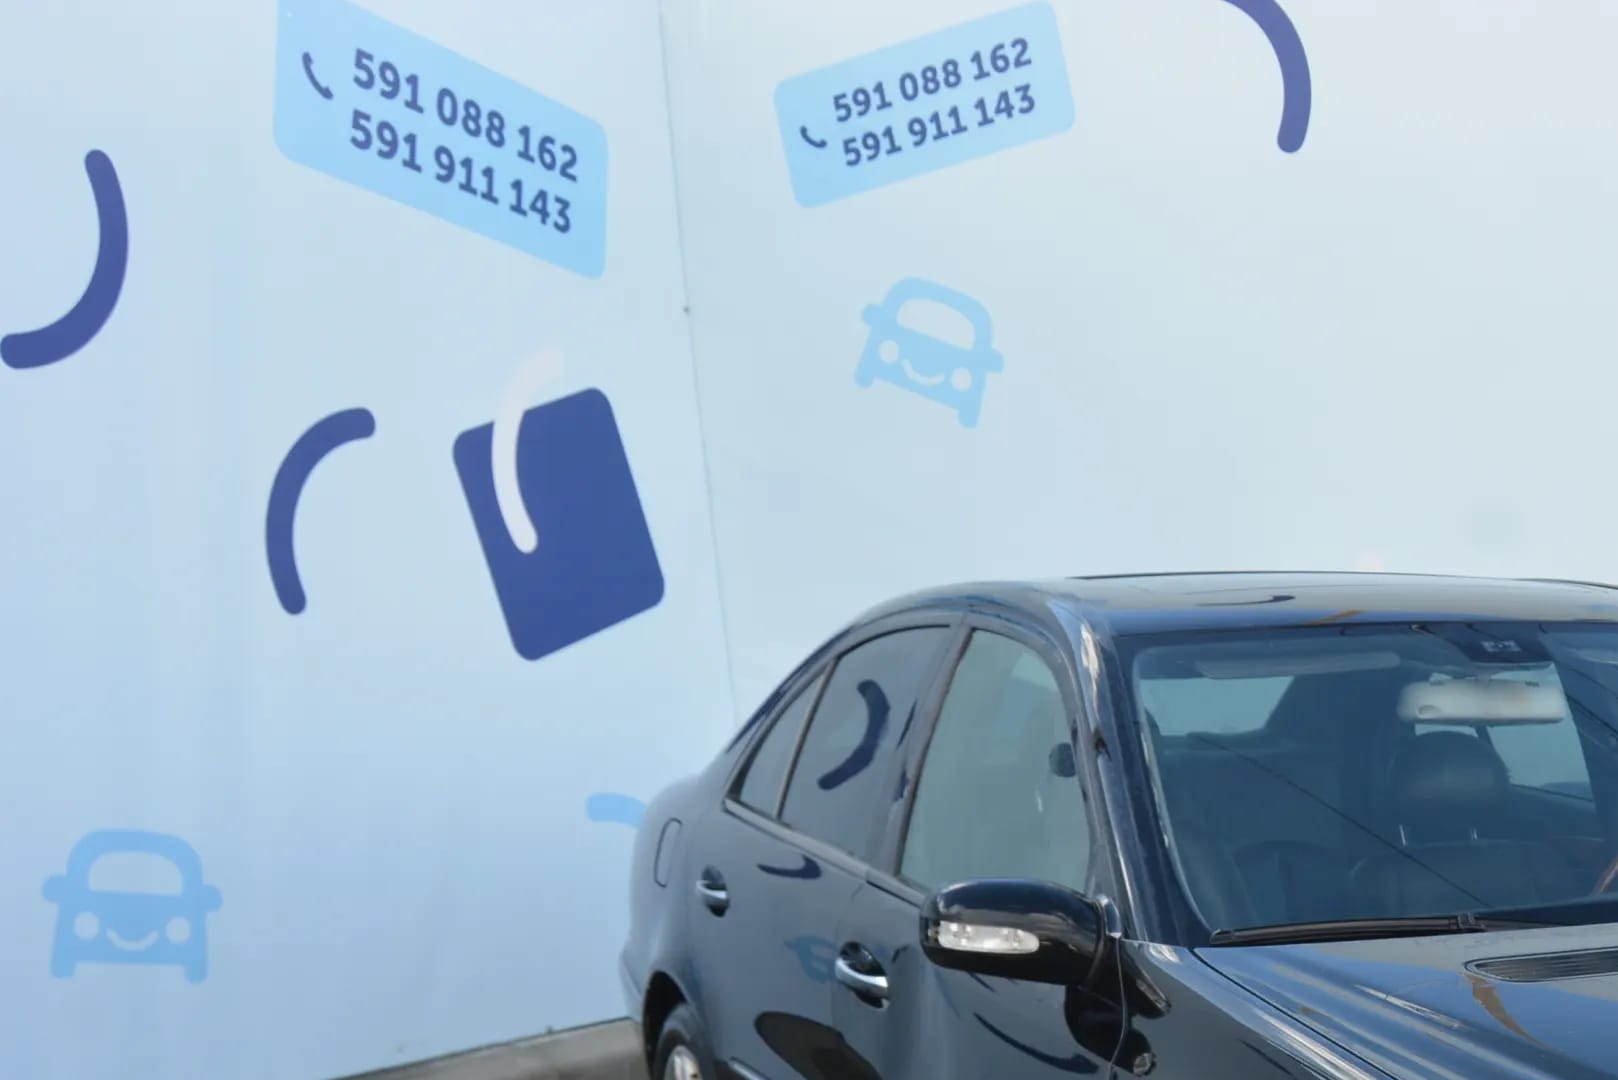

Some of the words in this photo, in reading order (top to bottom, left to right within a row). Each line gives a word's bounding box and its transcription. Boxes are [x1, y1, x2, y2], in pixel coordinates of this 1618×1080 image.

[353, 49, 424, 115] 591
[436, 87, 506, 149] 088
[517, 125, 577, 183] 162
[833, 81, 893, 123] 591
[899, 59, 962, 102] 088
[970, 38, 1032, 81] 162
[842, 125, 903, 167] 591
[907, 105, 968, 148] 911
[974, 83, 1035, 127] 143
[350, 109, 422, 173] 591
[434, 145, 499, 206] 911
[509, 178, 571, 234] 143
